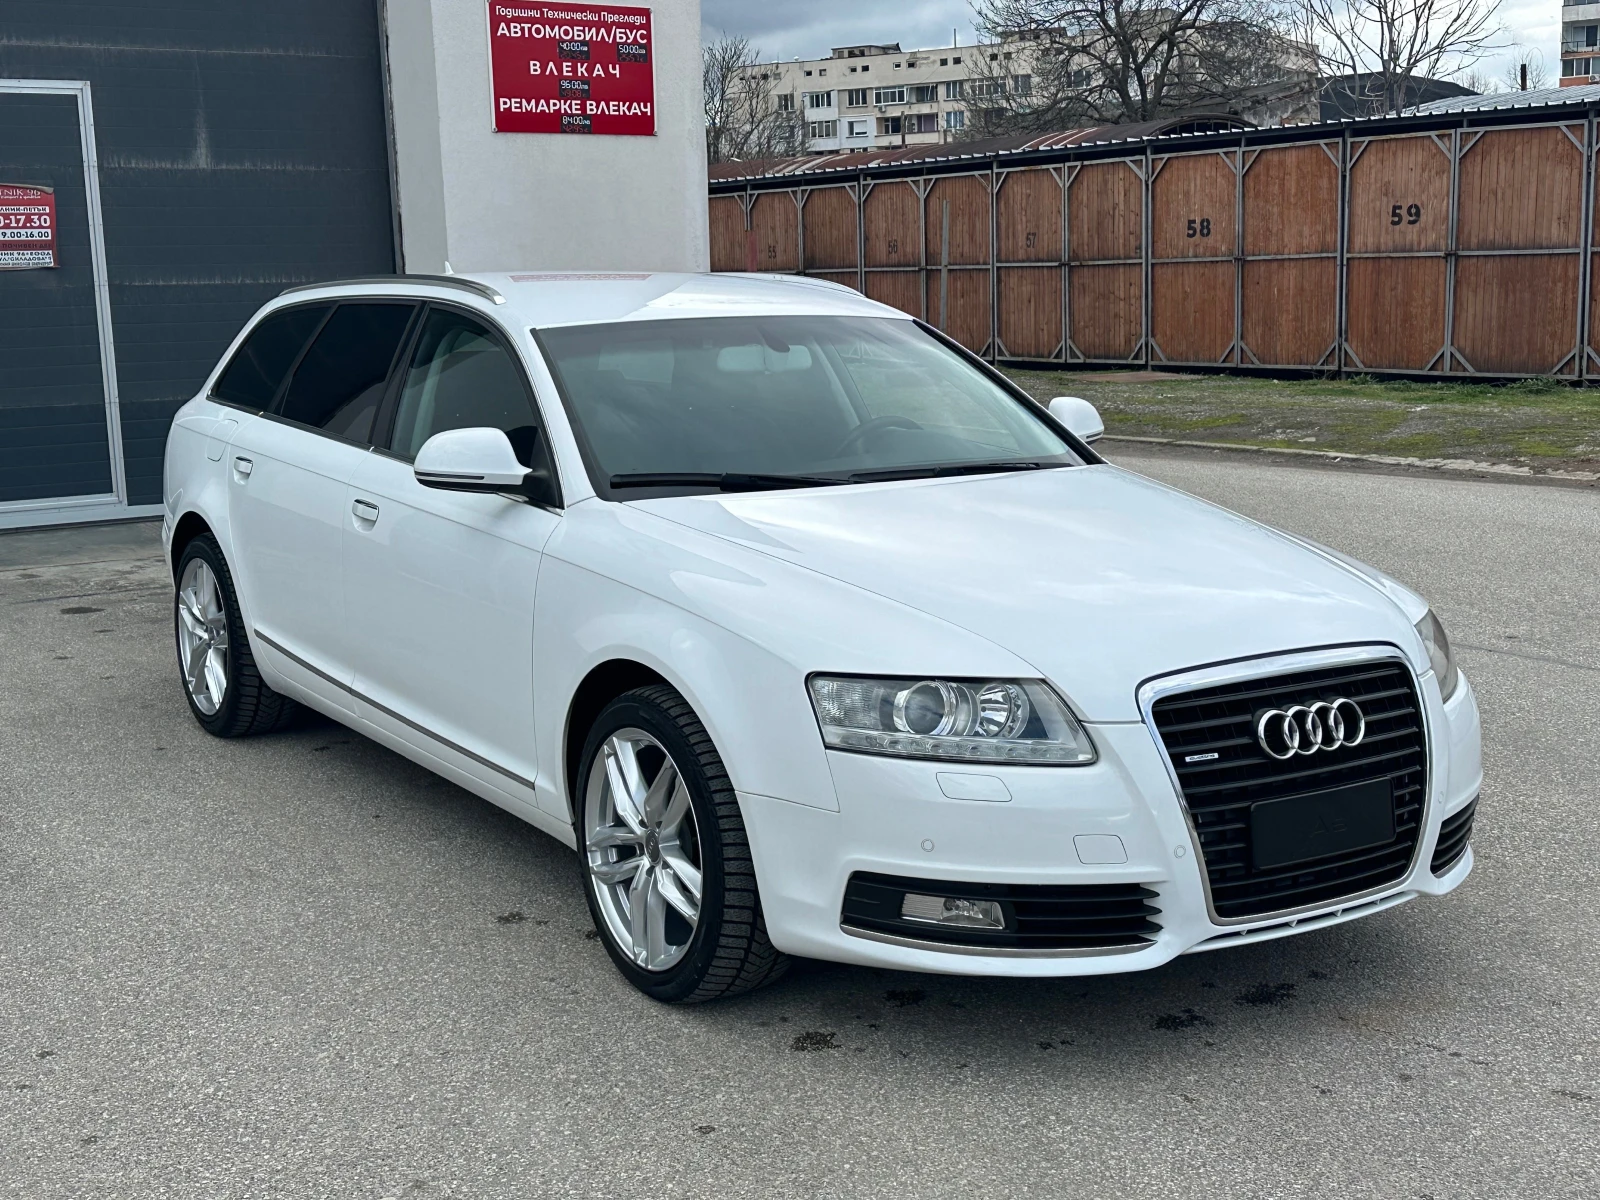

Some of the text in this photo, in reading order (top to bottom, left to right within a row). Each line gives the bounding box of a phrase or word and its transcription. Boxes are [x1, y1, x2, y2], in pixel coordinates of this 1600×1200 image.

[495, 5, 647, 25] Годишни Технически Прегледи
[497, 22, 648, 44] АВТОМОБИЛ/БУС
[499, 98, 651, 116] РЕМАРКЕ ВЛЕКАЧ
[1390, 203, 1421, 226] 59
[1186, 218, 1212, 238] 58
[887, 239, 898, 254] 56
[1025, 232, 1037, 248] 57
